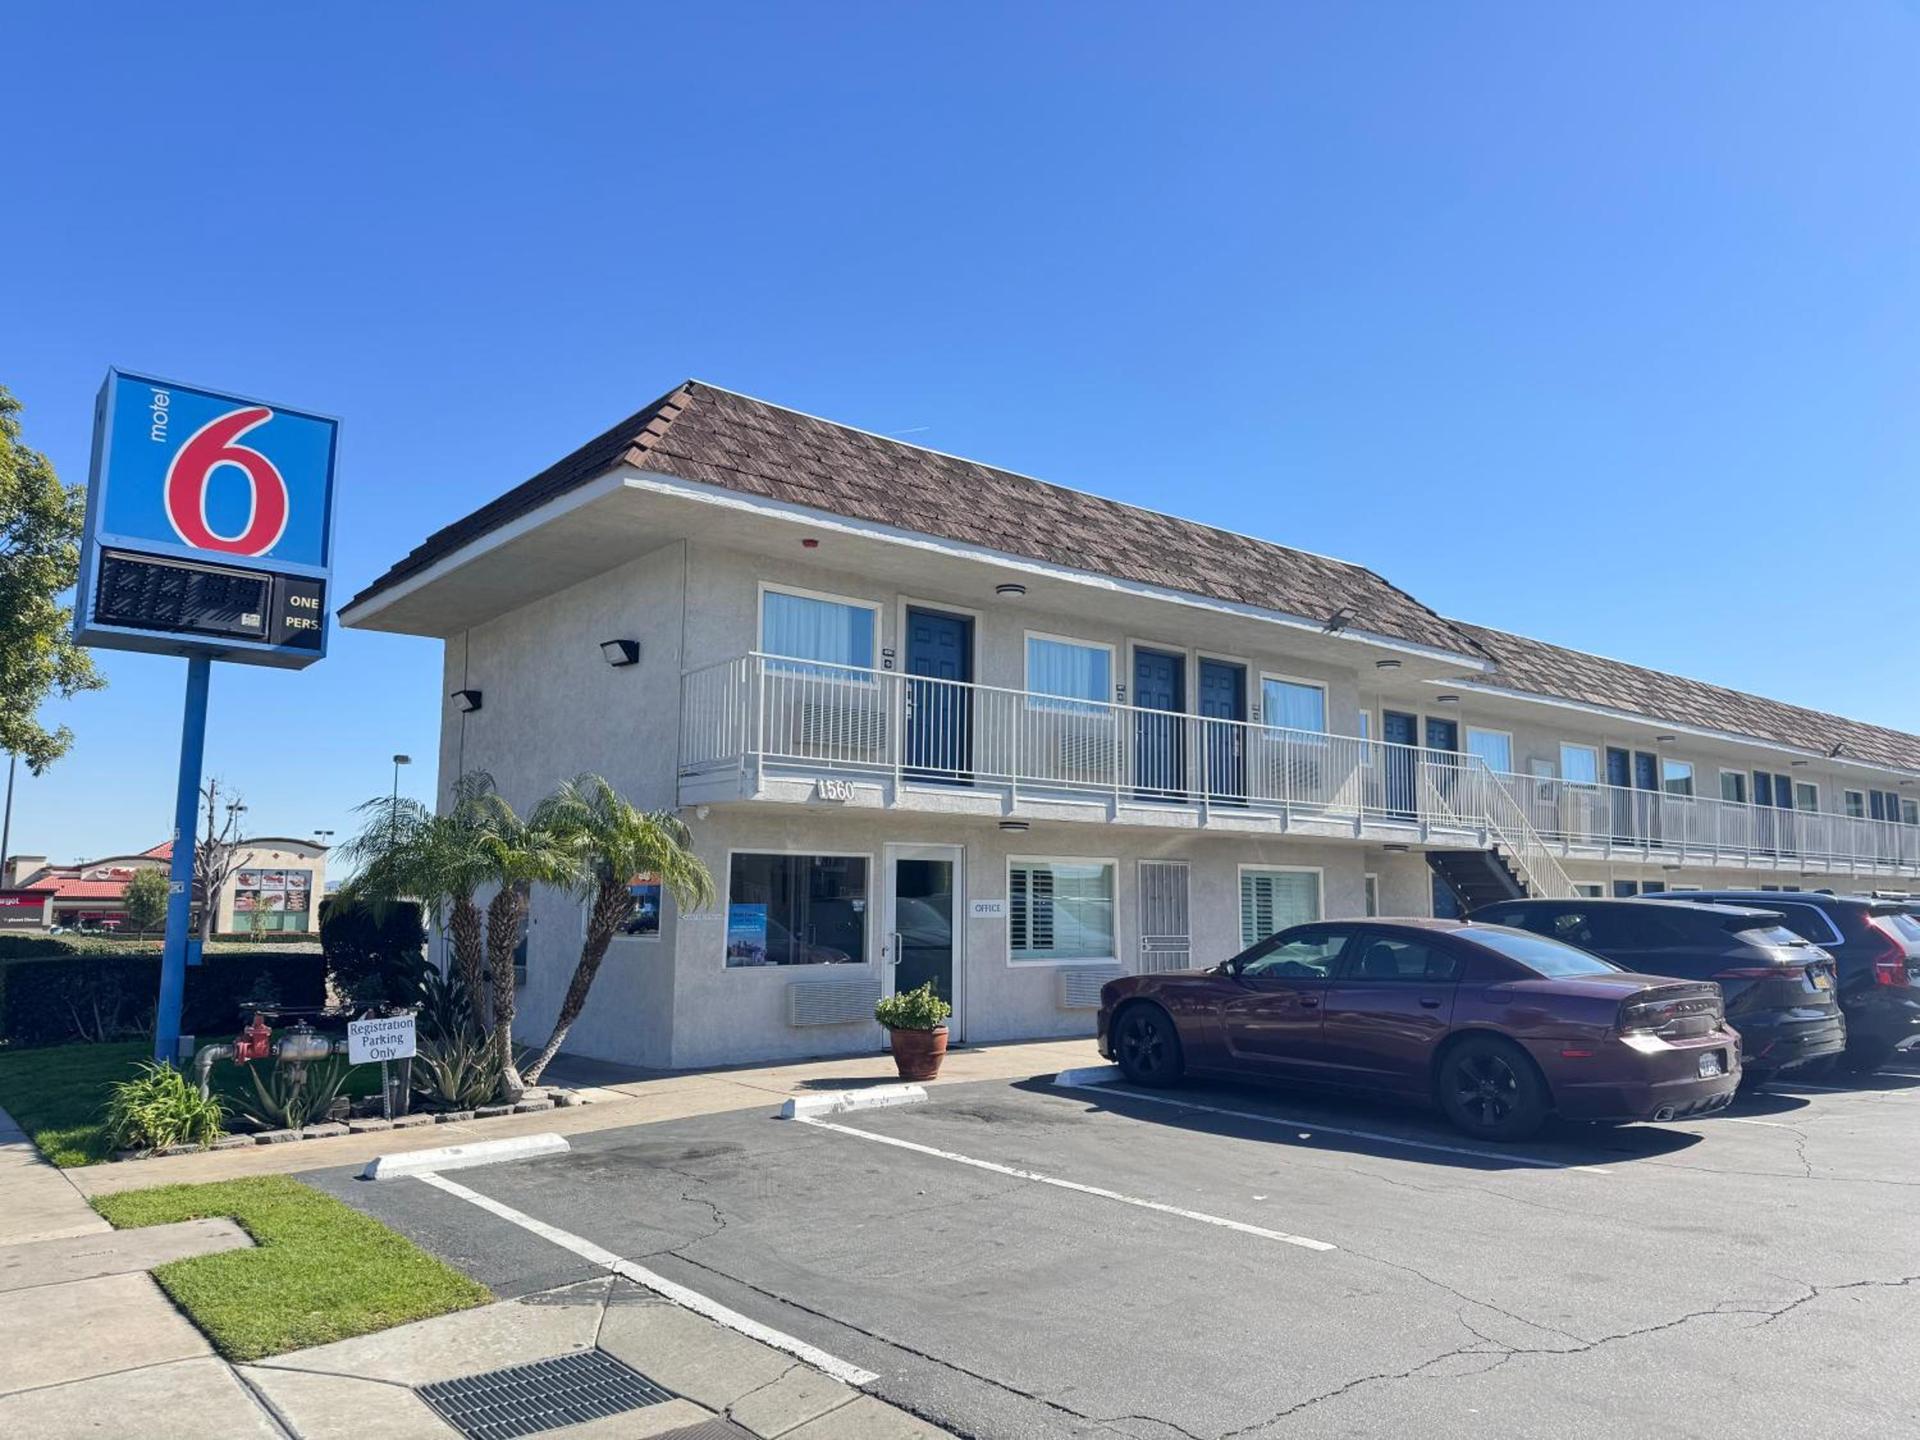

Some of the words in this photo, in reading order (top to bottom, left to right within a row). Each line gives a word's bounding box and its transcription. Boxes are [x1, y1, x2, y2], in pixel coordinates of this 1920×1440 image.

[149, 388, 170, 443] motel
[164, 406, 289, 557] 6
[290, 595, 320, 609] ONE
[818, 779, 855, 801] 1560
[975, 903, 1001, 913] OFFICE
[350, 1019, 413, 1036] Registration
[362, 1034, 404, 1047] Parking
[370, 1047, 397, 1060] Only
